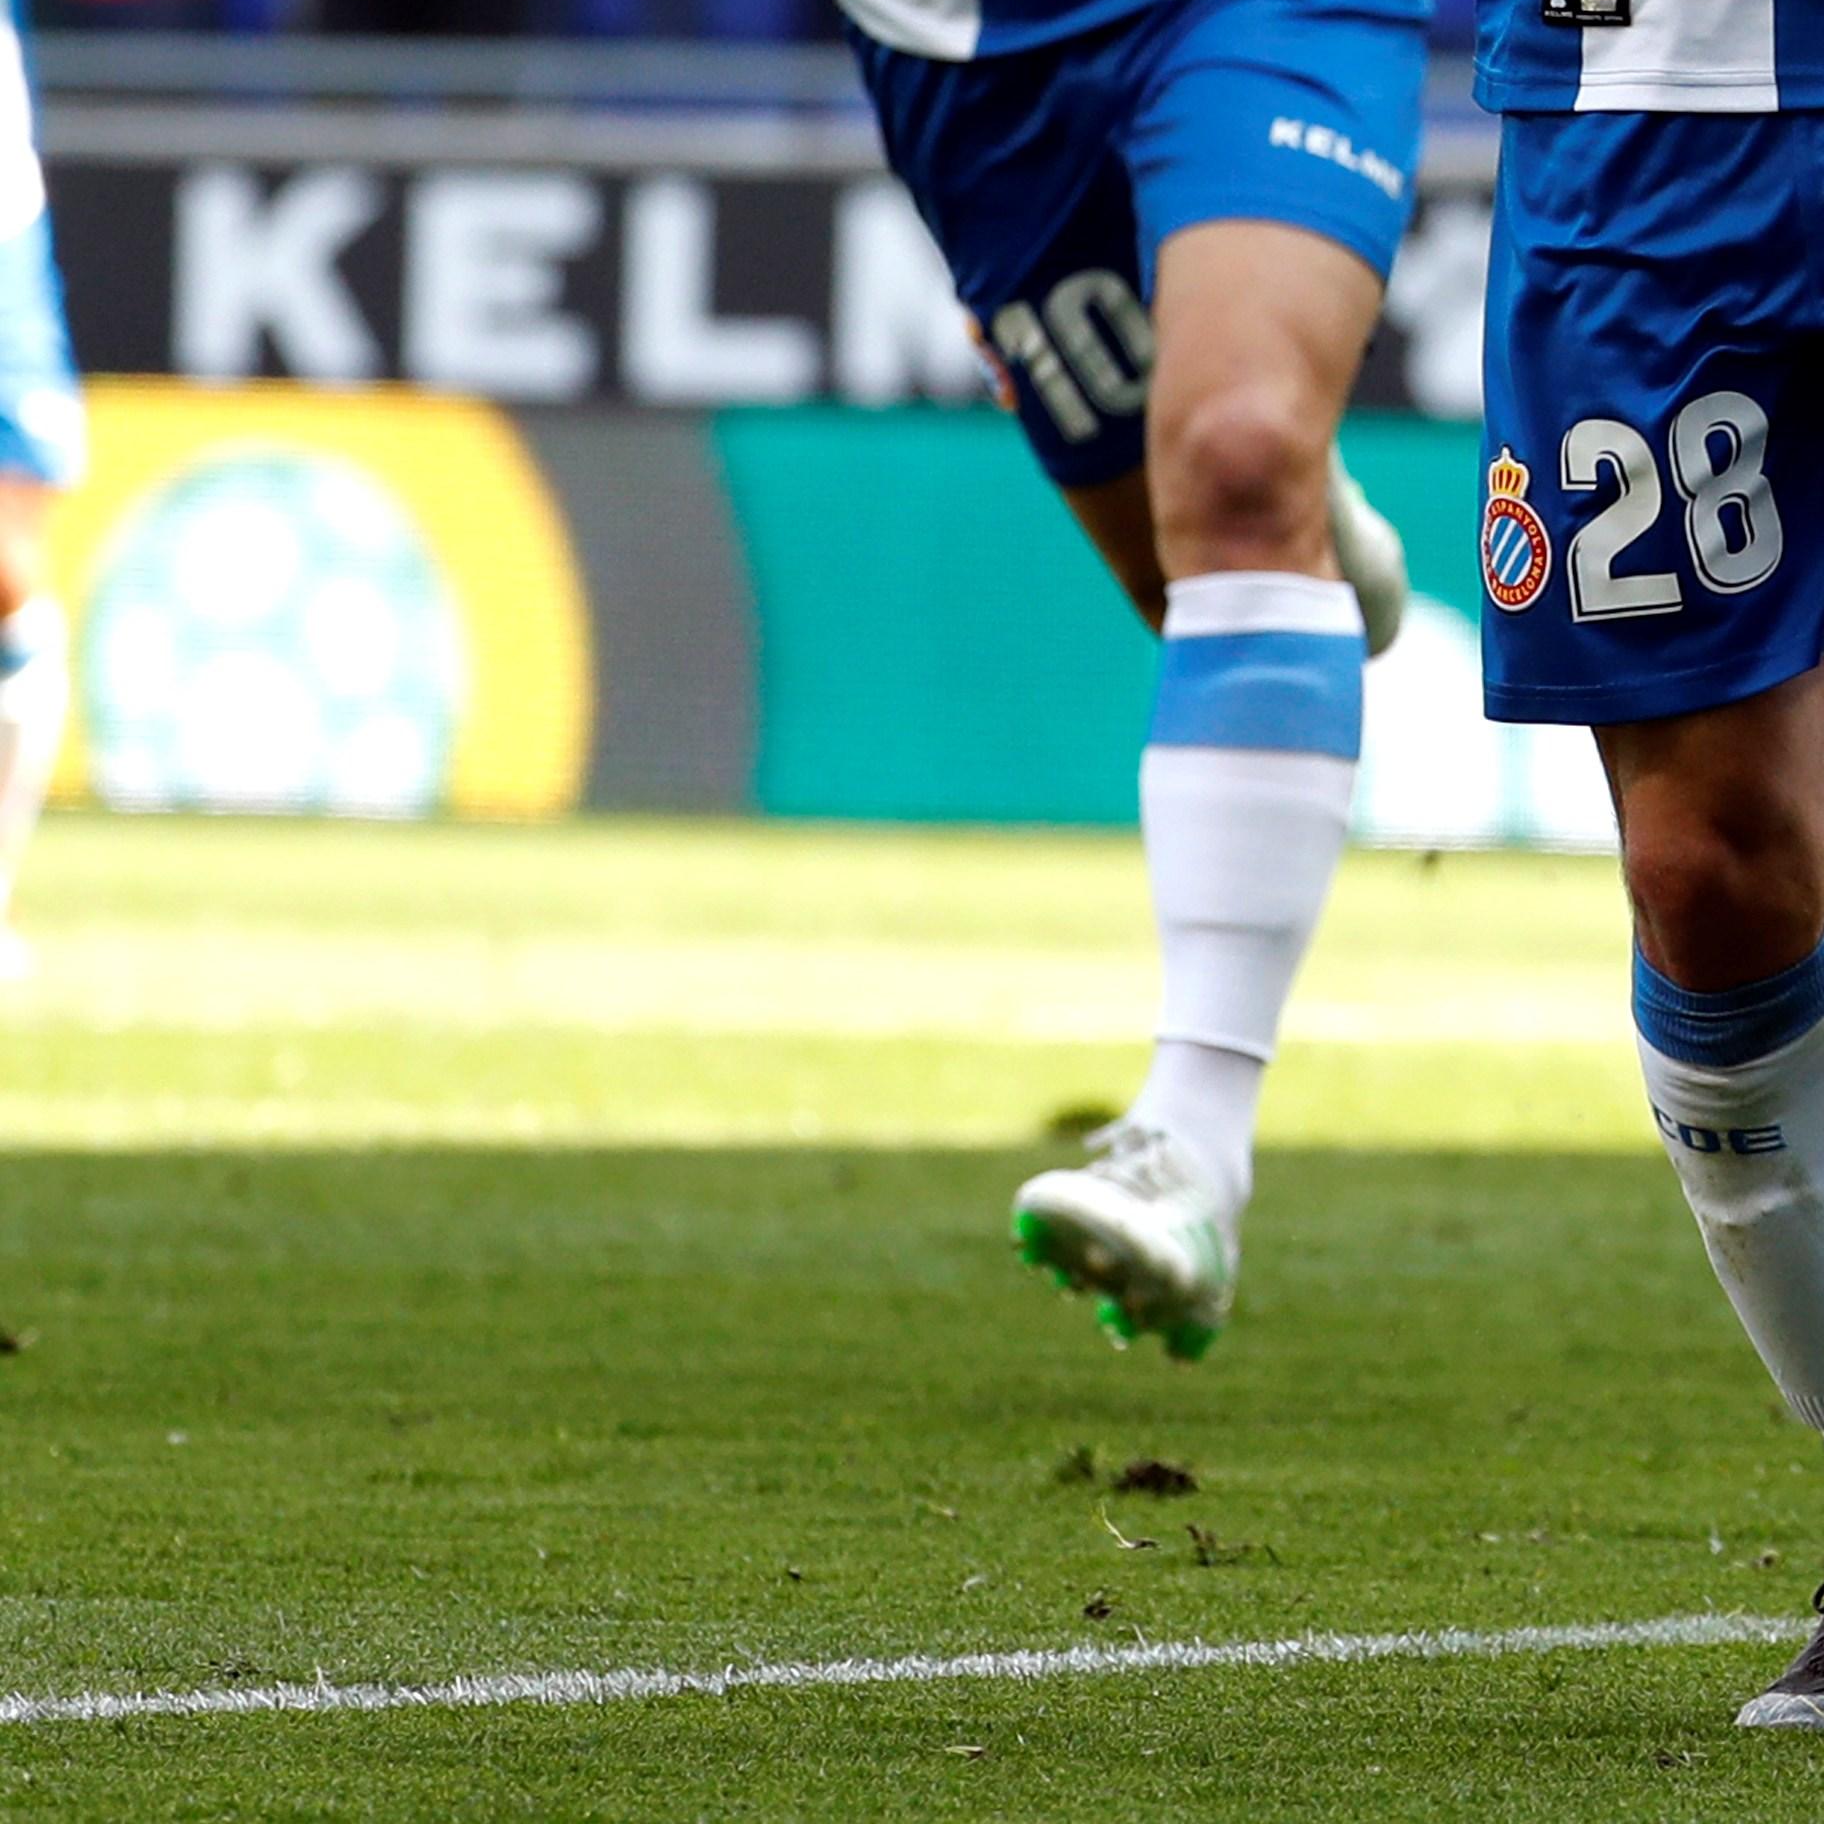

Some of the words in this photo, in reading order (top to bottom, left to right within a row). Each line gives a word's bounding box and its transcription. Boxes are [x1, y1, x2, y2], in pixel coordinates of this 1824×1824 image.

[1268, 116, 1405, 201] KELME
[991, 266, 1157, 445] 10
[1560, 390, 1784, 624] 28
